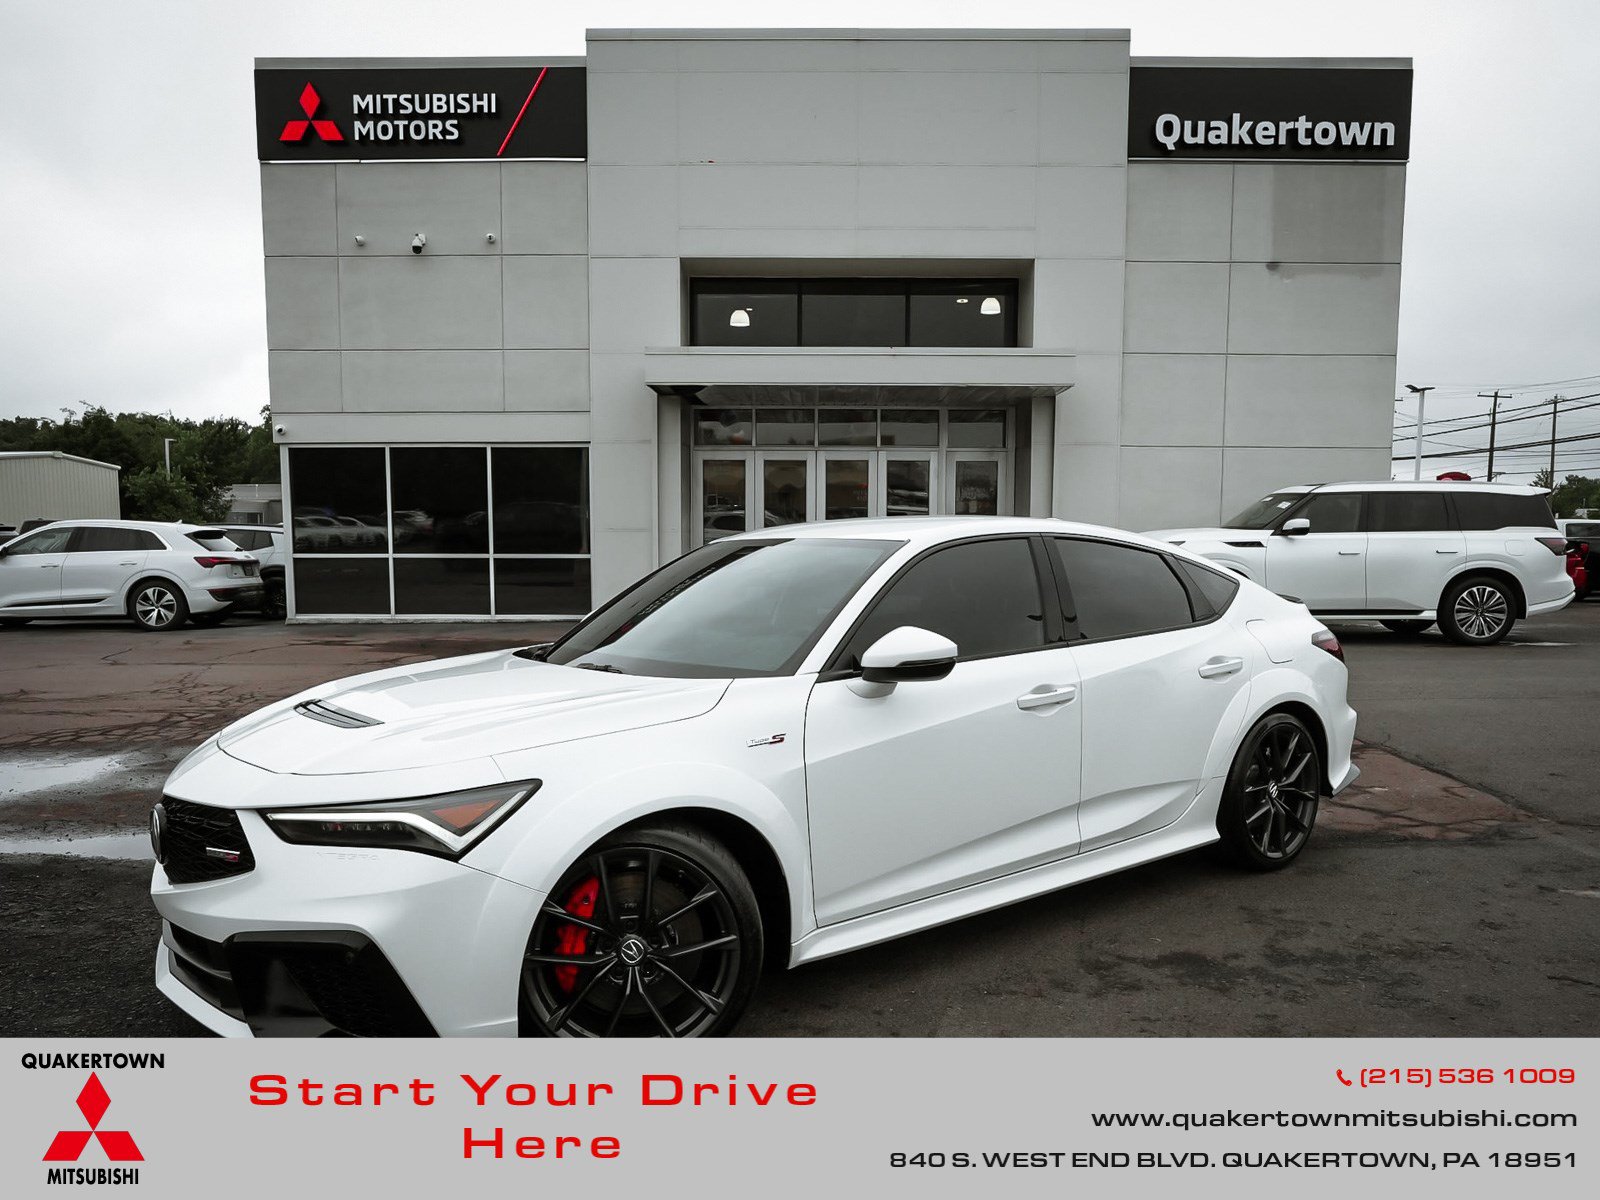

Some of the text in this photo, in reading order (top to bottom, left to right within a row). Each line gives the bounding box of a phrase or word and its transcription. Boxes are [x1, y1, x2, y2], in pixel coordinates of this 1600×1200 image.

[352, 92, 497, 115] MITSUBISHI
[353, 119, 460, 142] MOTORS
[1154, 112, 1396, 151] Quakertown
